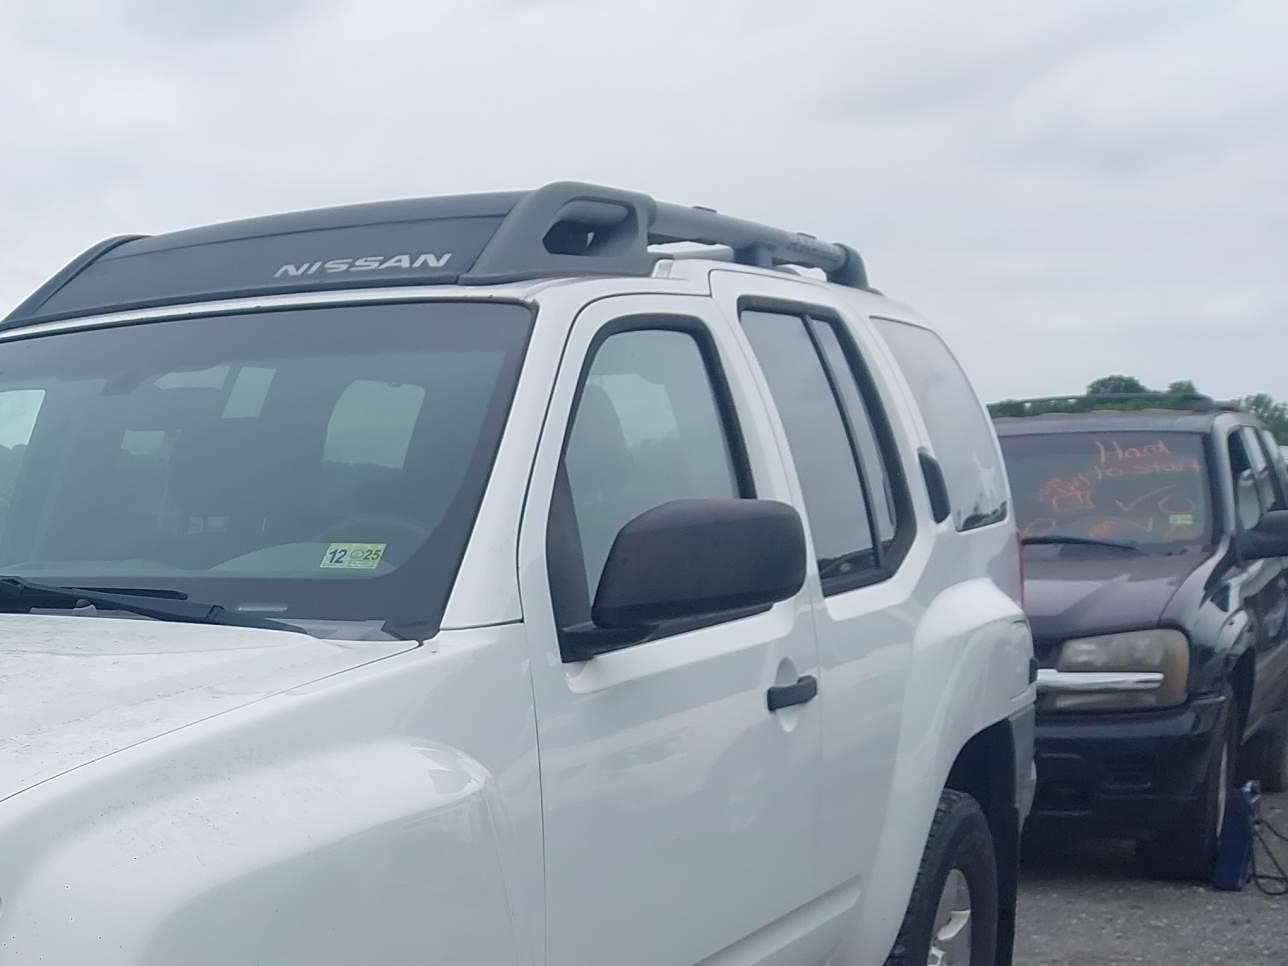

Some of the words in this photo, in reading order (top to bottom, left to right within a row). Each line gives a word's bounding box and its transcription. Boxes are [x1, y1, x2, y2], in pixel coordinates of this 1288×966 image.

[274, 253, 452, 277] NISSAN
[328, 549, 347, 564] 12
[362, 549, 381, 560] 25
